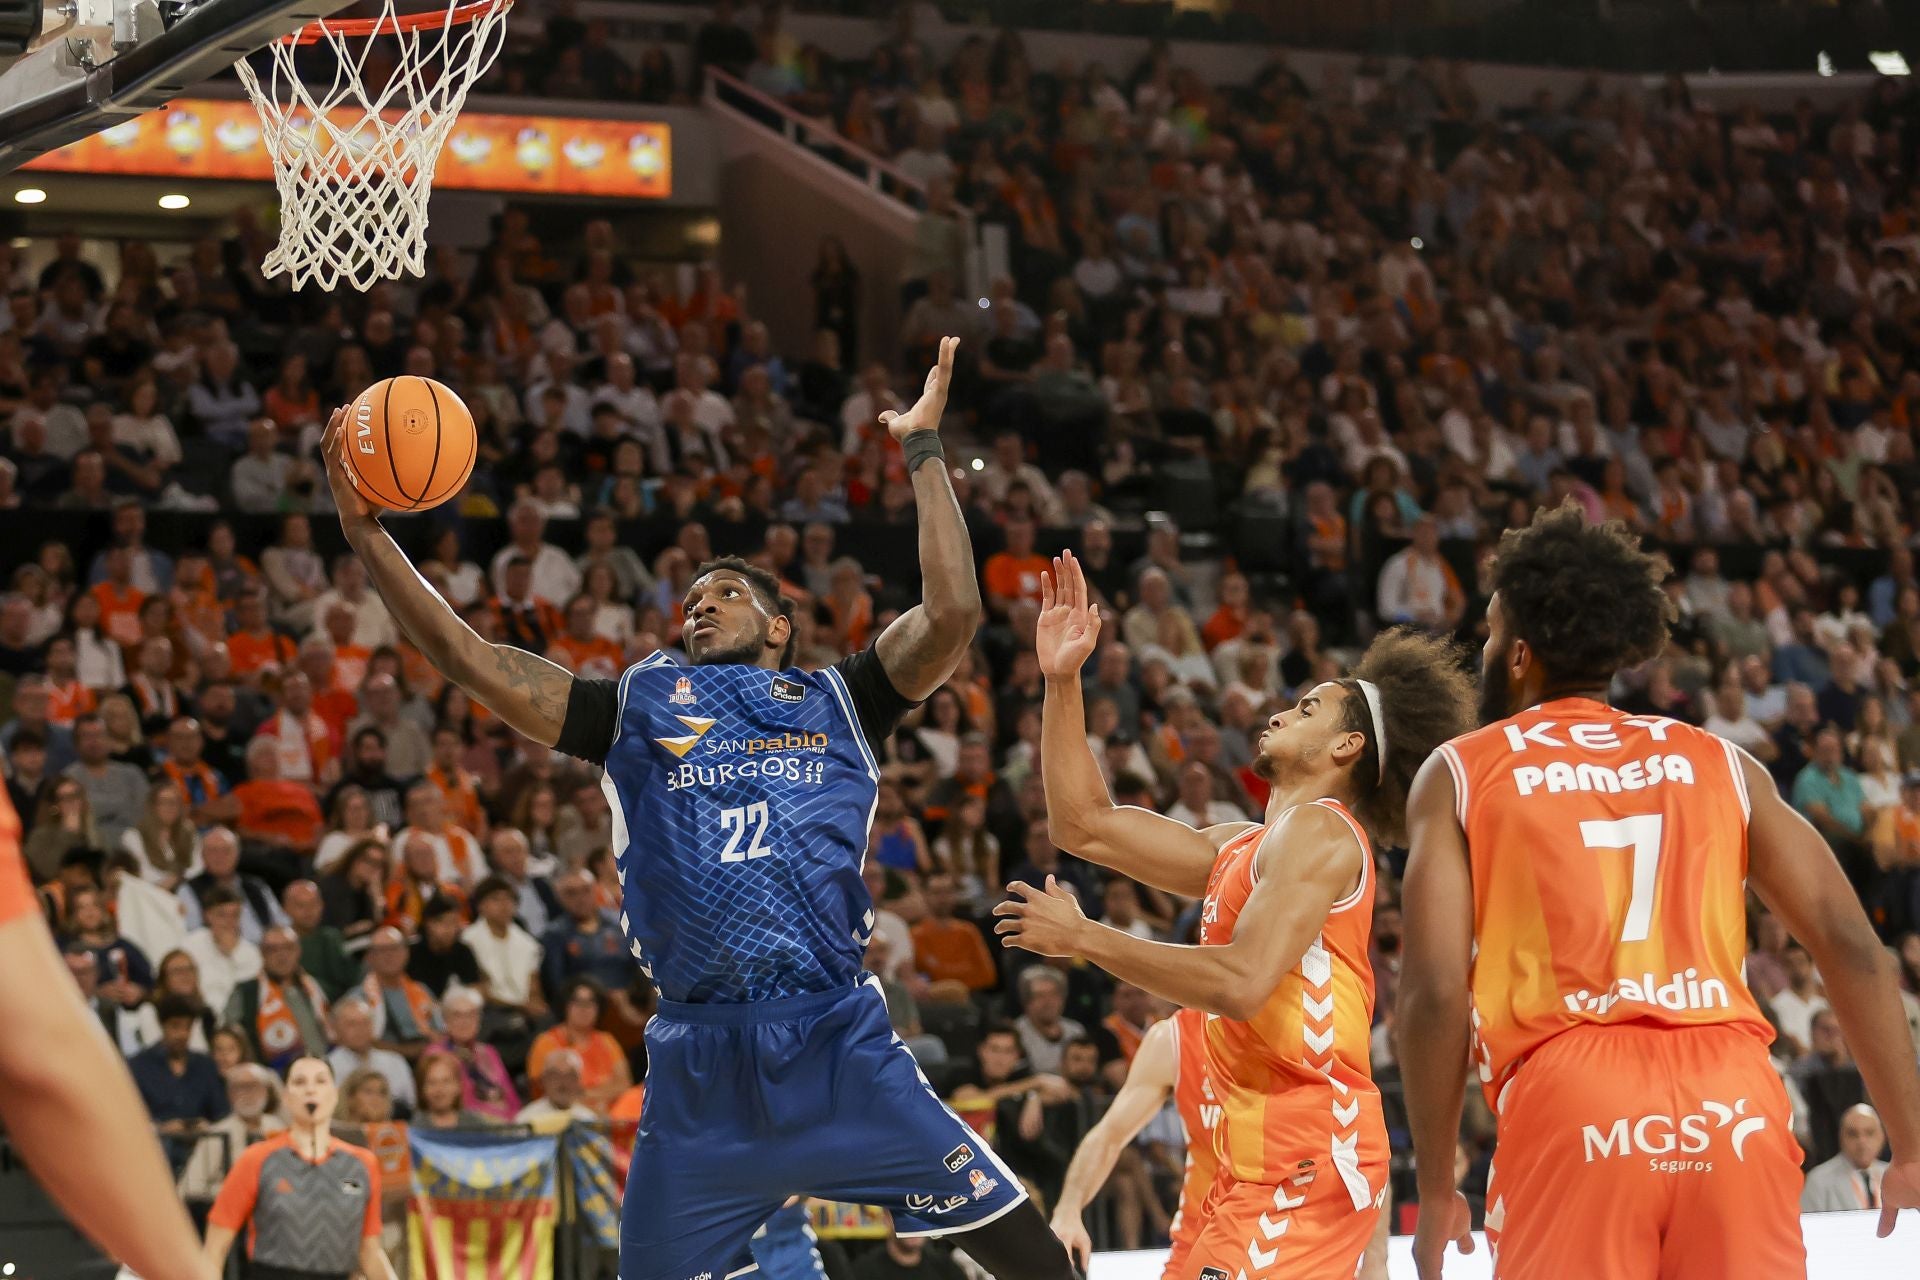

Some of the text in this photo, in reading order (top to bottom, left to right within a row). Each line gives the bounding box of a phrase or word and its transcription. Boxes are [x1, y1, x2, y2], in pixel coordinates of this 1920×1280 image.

[1503, 718, 1678, 752] KEY
[1512, 754, 1695, 796] PAMESA
[720, 800, 771, 863] 22
[1578, 813, 1663, 942] 7
[1582, 1114, 1711, 1163] MGS
[1649, 1158, 1713, 1174] Seguros
